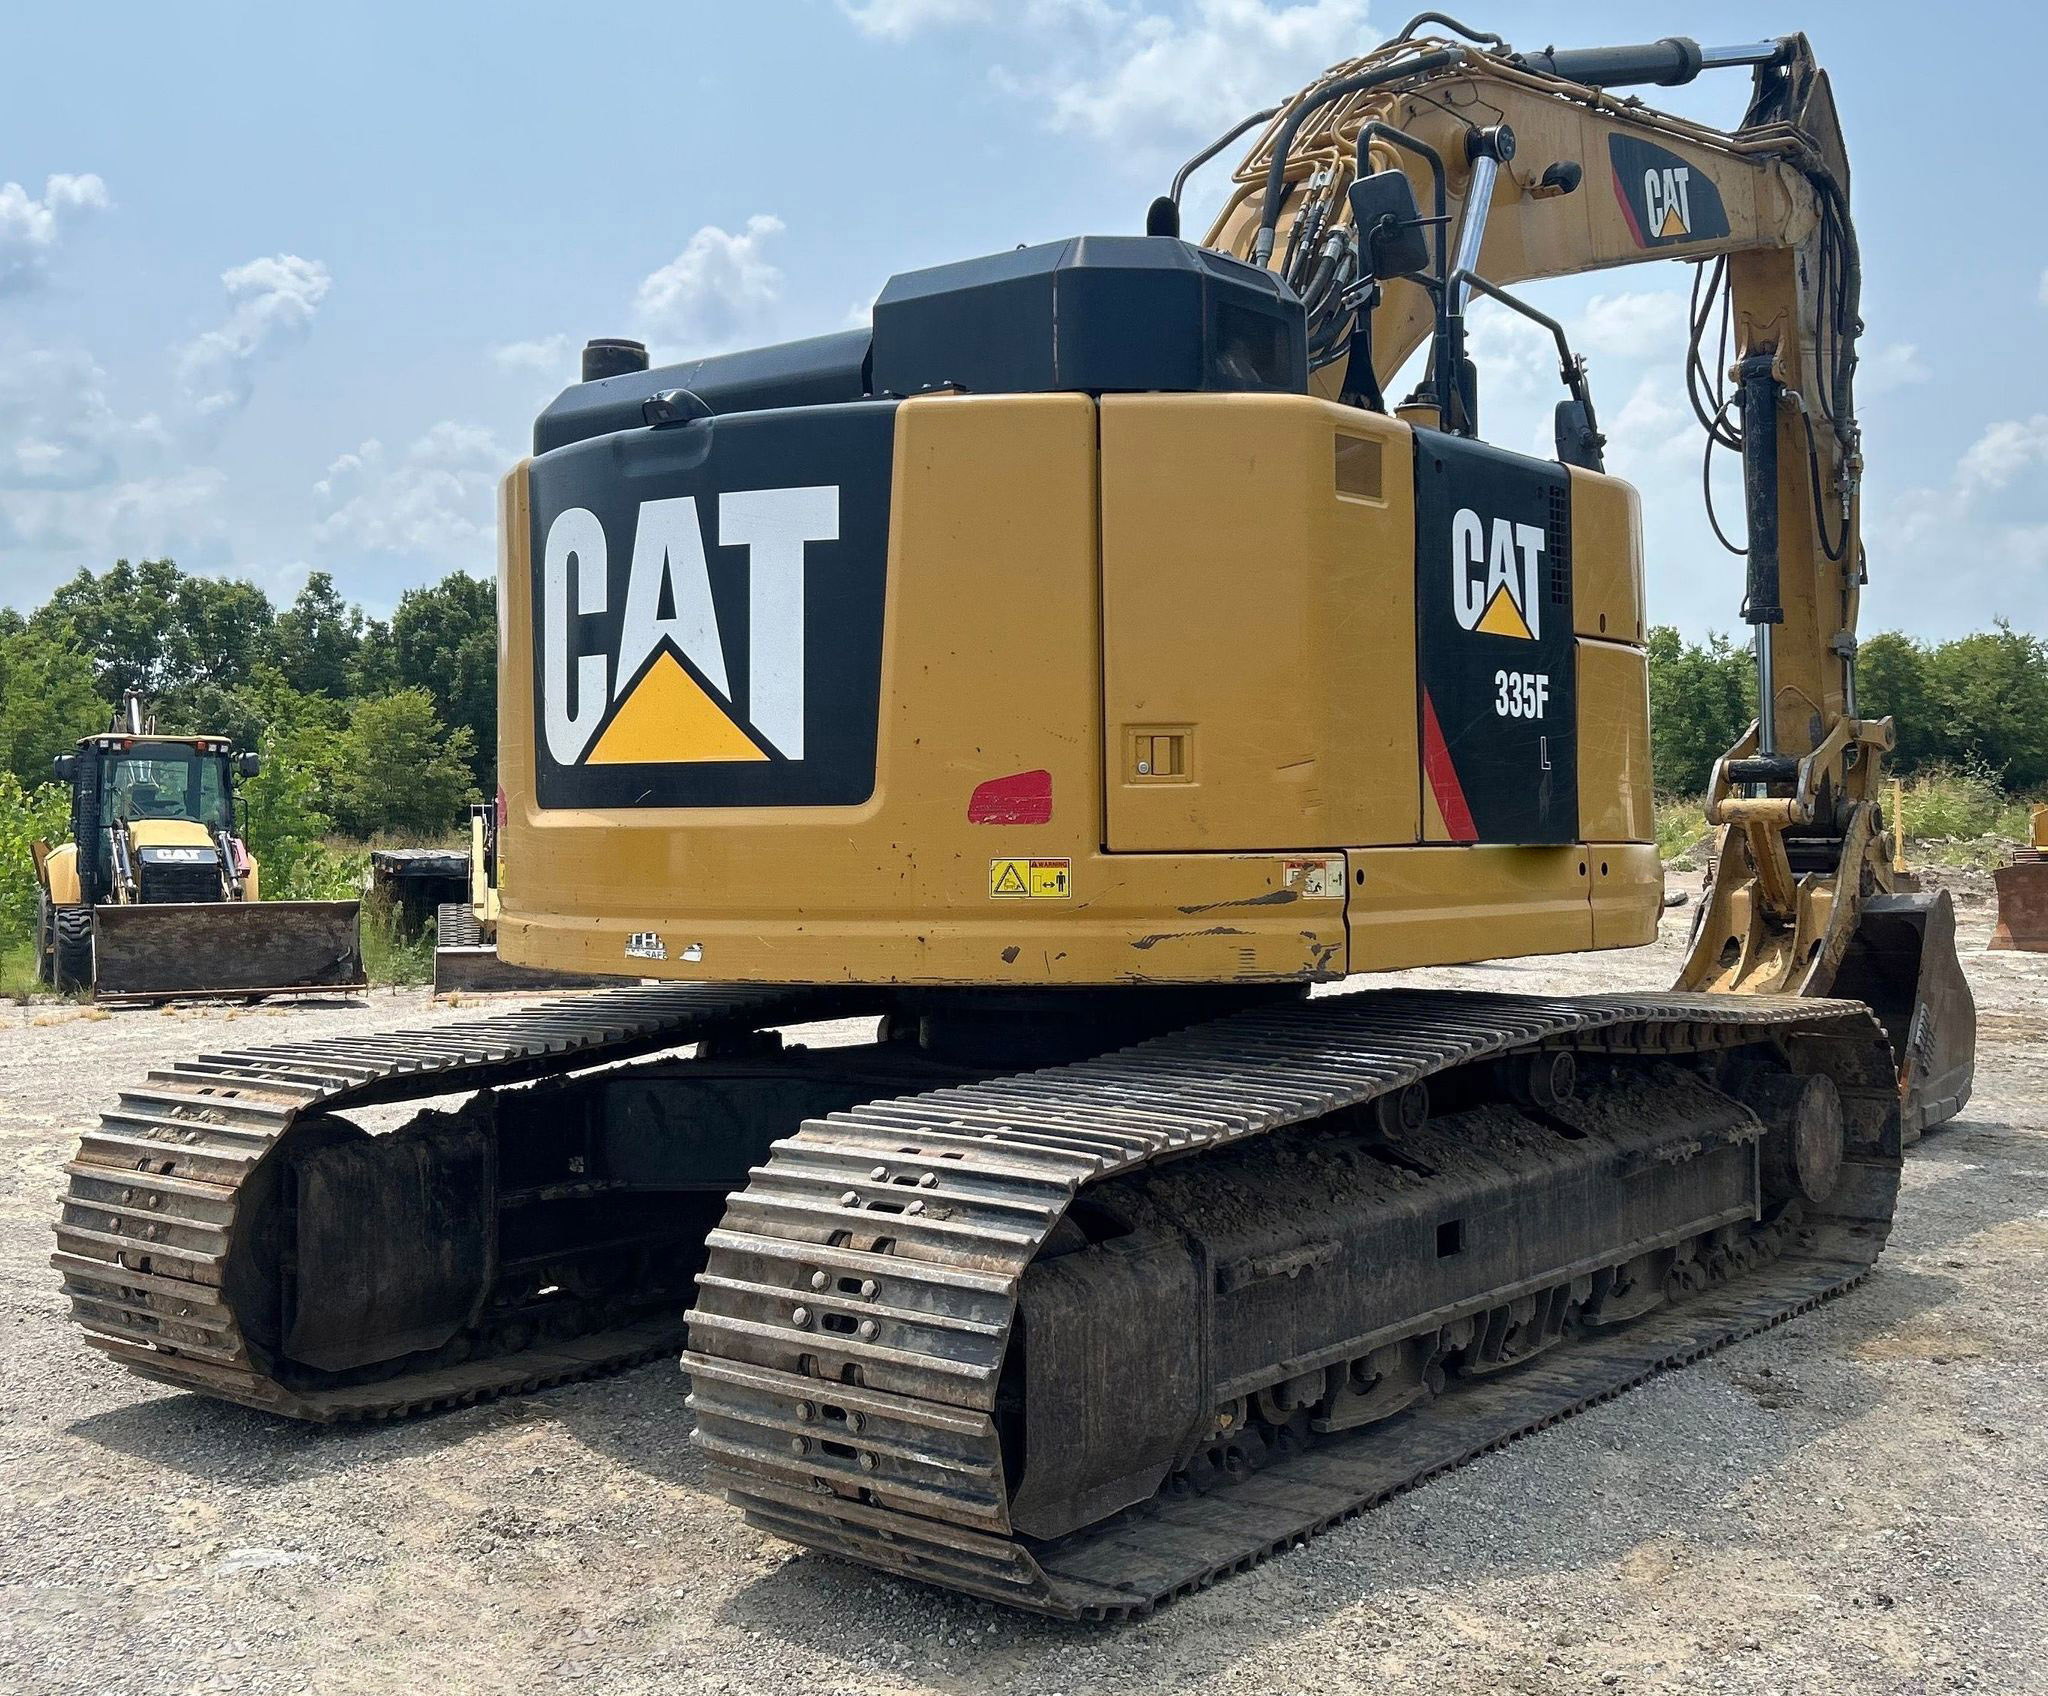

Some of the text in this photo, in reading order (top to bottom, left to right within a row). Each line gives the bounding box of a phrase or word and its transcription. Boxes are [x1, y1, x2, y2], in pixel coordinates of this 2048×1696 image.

[1644, 167, 1691, 237] CAT
[1452, 508, 1546, 640] CAT
[544, 485, 840, 766] CAT
[1495, 669, 1549, 719] 335F
[1540, 736, 1551, 770] L
[156, 849, 200, 860] CAT
